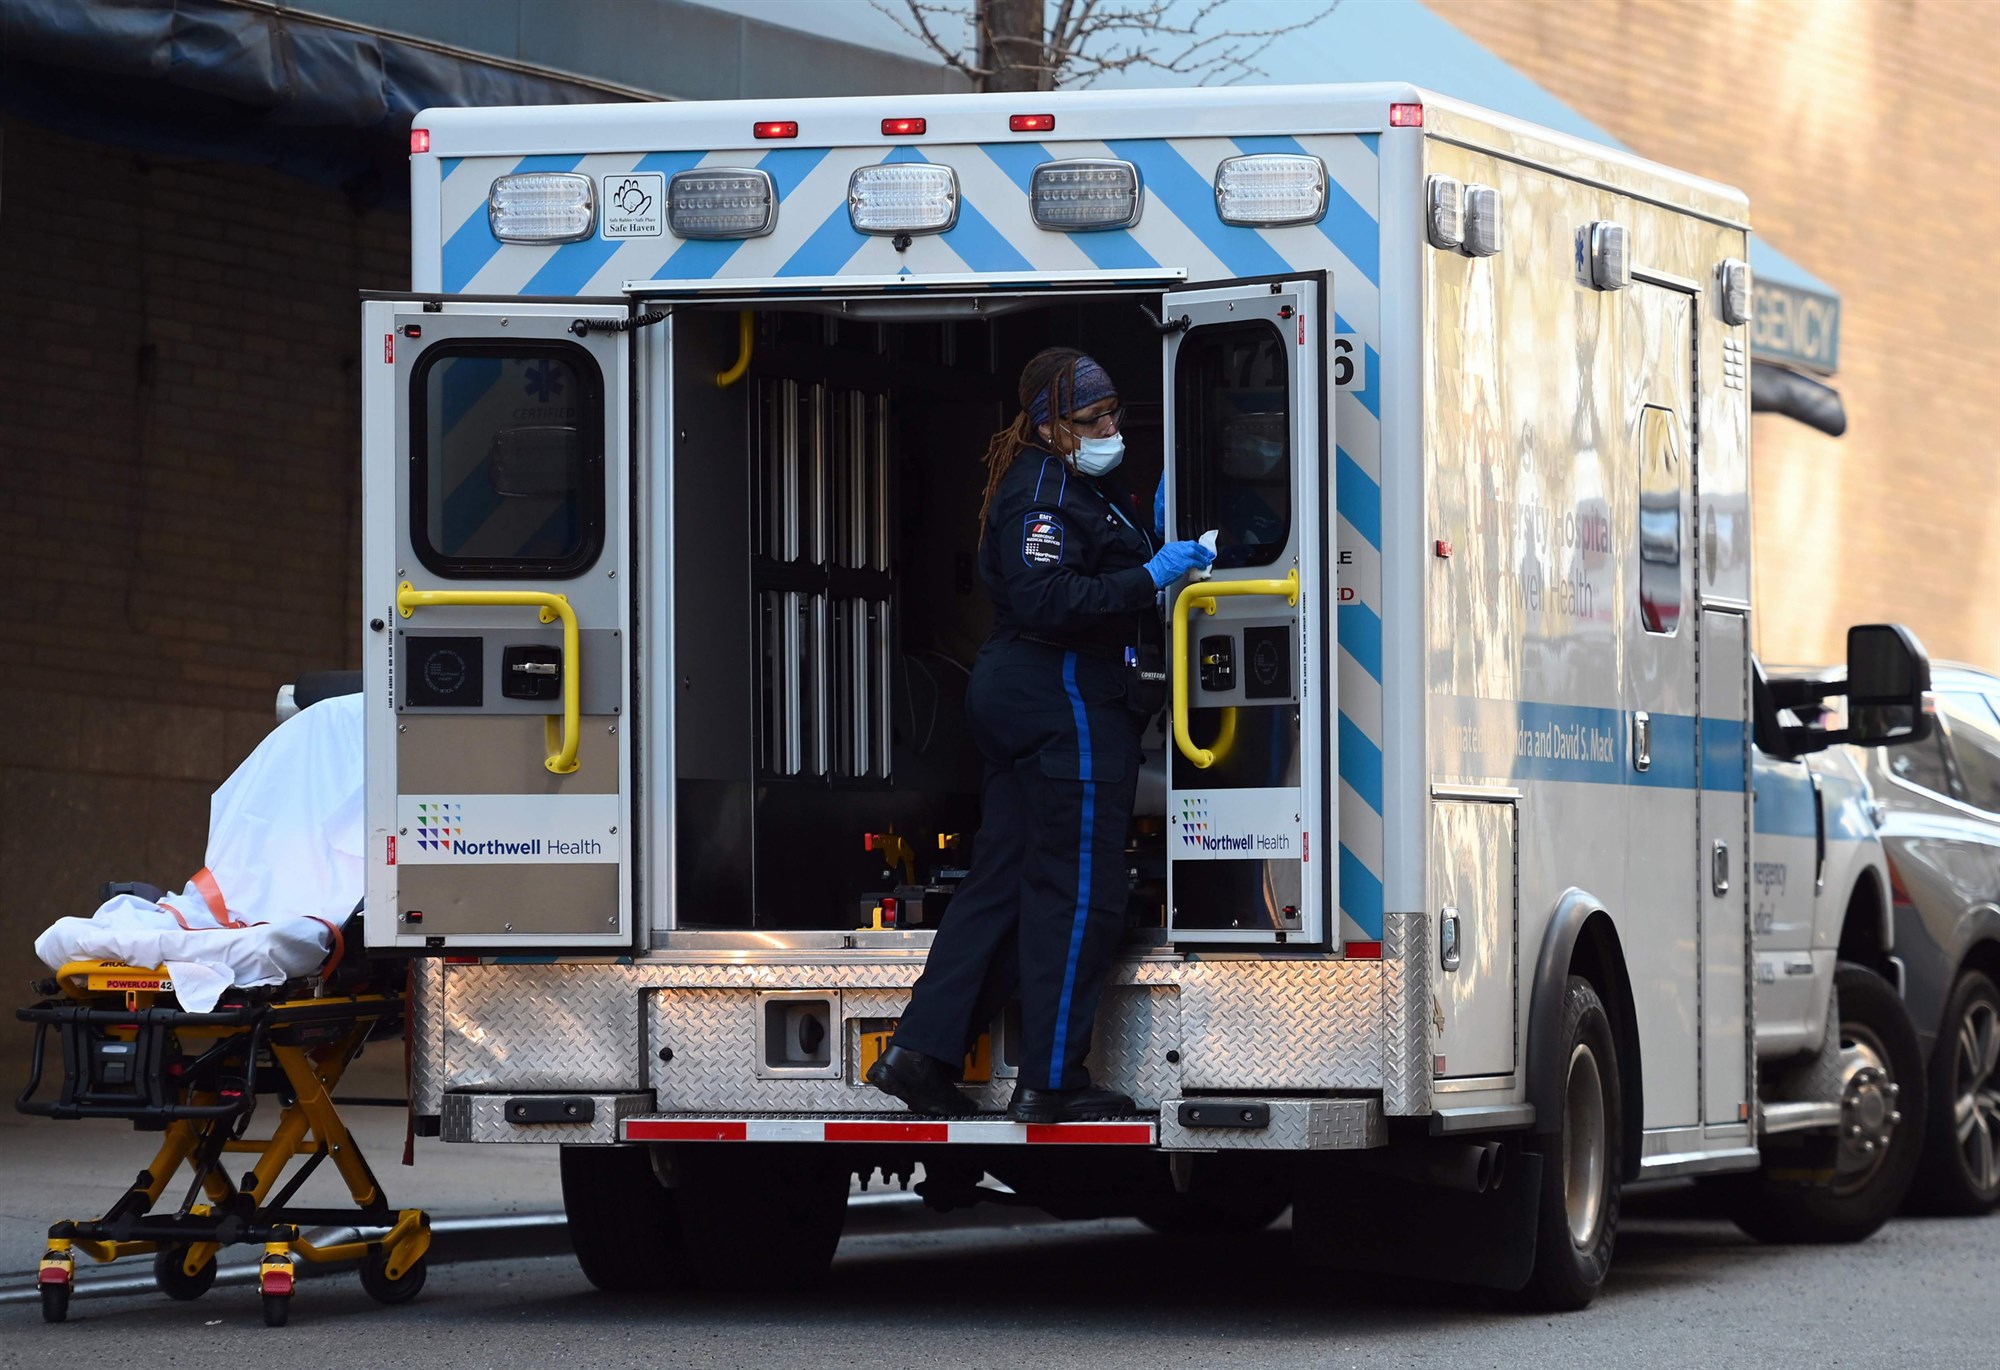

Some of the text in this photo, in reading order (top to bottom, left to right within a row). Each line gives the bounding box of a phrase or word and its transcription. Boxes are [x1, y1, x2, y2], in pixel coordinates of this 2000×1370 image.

[610, 223, 655, 232] Safe Haven
[513, 407, 576, 420] CERTIFIED
[1522, 421, 1565, 480] Shore
[1039, 513, 1052, 521] EMT
[1554, 501, 1612, 560] Hospital
[1043, 538, 1060, 546] SERVICES
[1337, 551, 1353, 565] E
[1336, 587, 1355, 601] D
[1550, 566, 1593, 618] Health
[1443, 715, 1484, 753] Donated
[1500, 719, 1533, 757] Sndra
[1534, 721, 1552, 759] and
[1553, 723, 1579, 761] David
[1581, 726, 1589, 762] S.
[1590, 727, 1614, 763] Mack
[453, 839, 602, 855] Northwell Health
[1202, 834, 1254, 850] Northwell
[1256, 833, 1290, 850] Health
[106, 980, 172, 990] POWERLOAD 42
